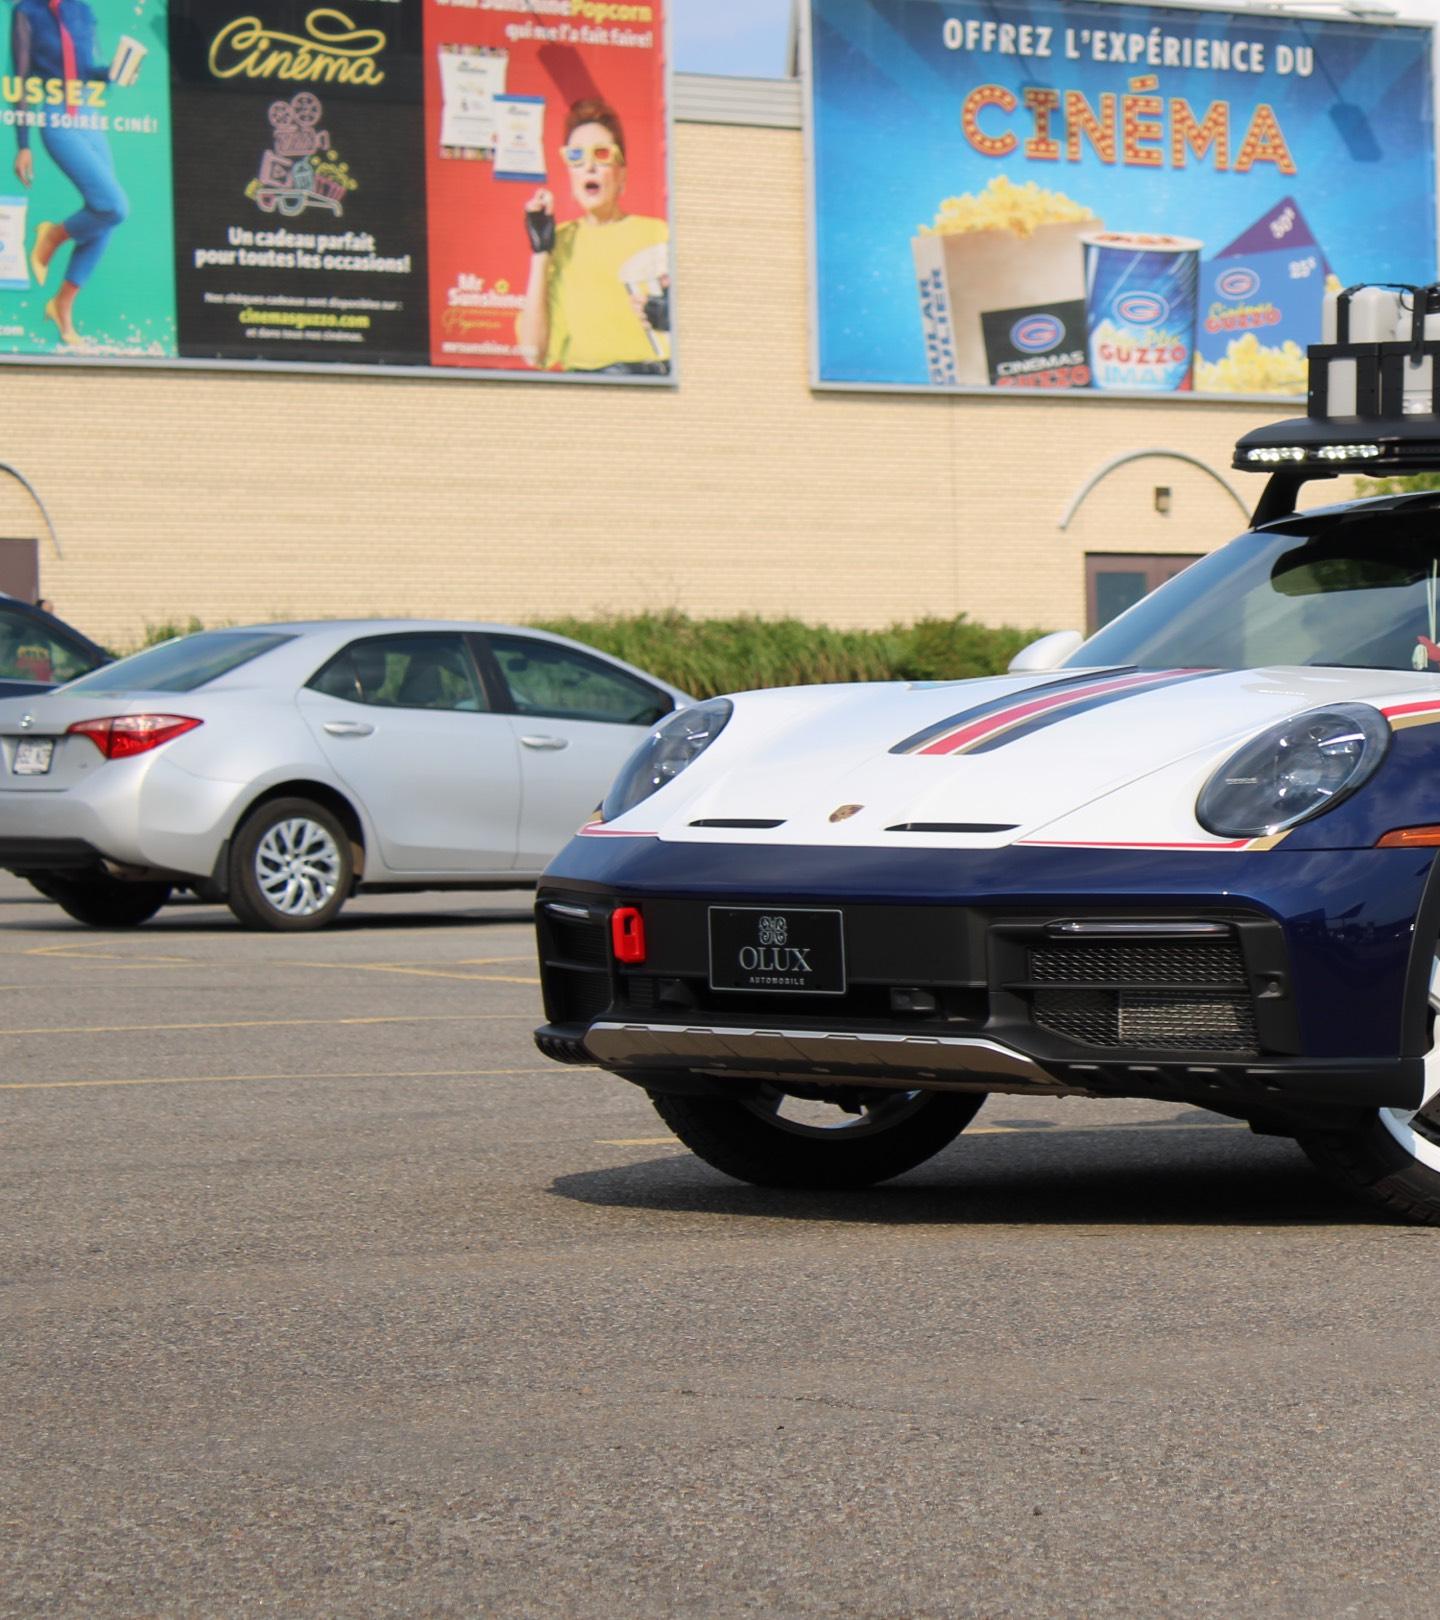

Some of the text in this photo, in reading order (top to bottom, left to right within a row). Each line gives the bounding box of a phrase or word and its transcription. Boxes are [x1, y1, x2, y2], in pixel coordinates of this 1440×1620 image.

[943, 18, 1314, 77] OFFREZ L'EXPÉRIENCE DU
[2, 75, 106, 107] USSEZ
[0, 109, 46, 127] OTRE
[51, 111, 109, 131] SOIRÉE
[961, 74, 1298, 174] CINÉMA
[228, 226, 377, 253] Un cadeau parfait
[195, 249, 412, 274] pour toutes les occasions!
[1204, 308, 1282, 334] GUZZO
[1100, 343, 1188, 364] GUZZO
[739, 946, 813, 972] OLUX
[749, 976, 805, 986] AUTOMOBILE
